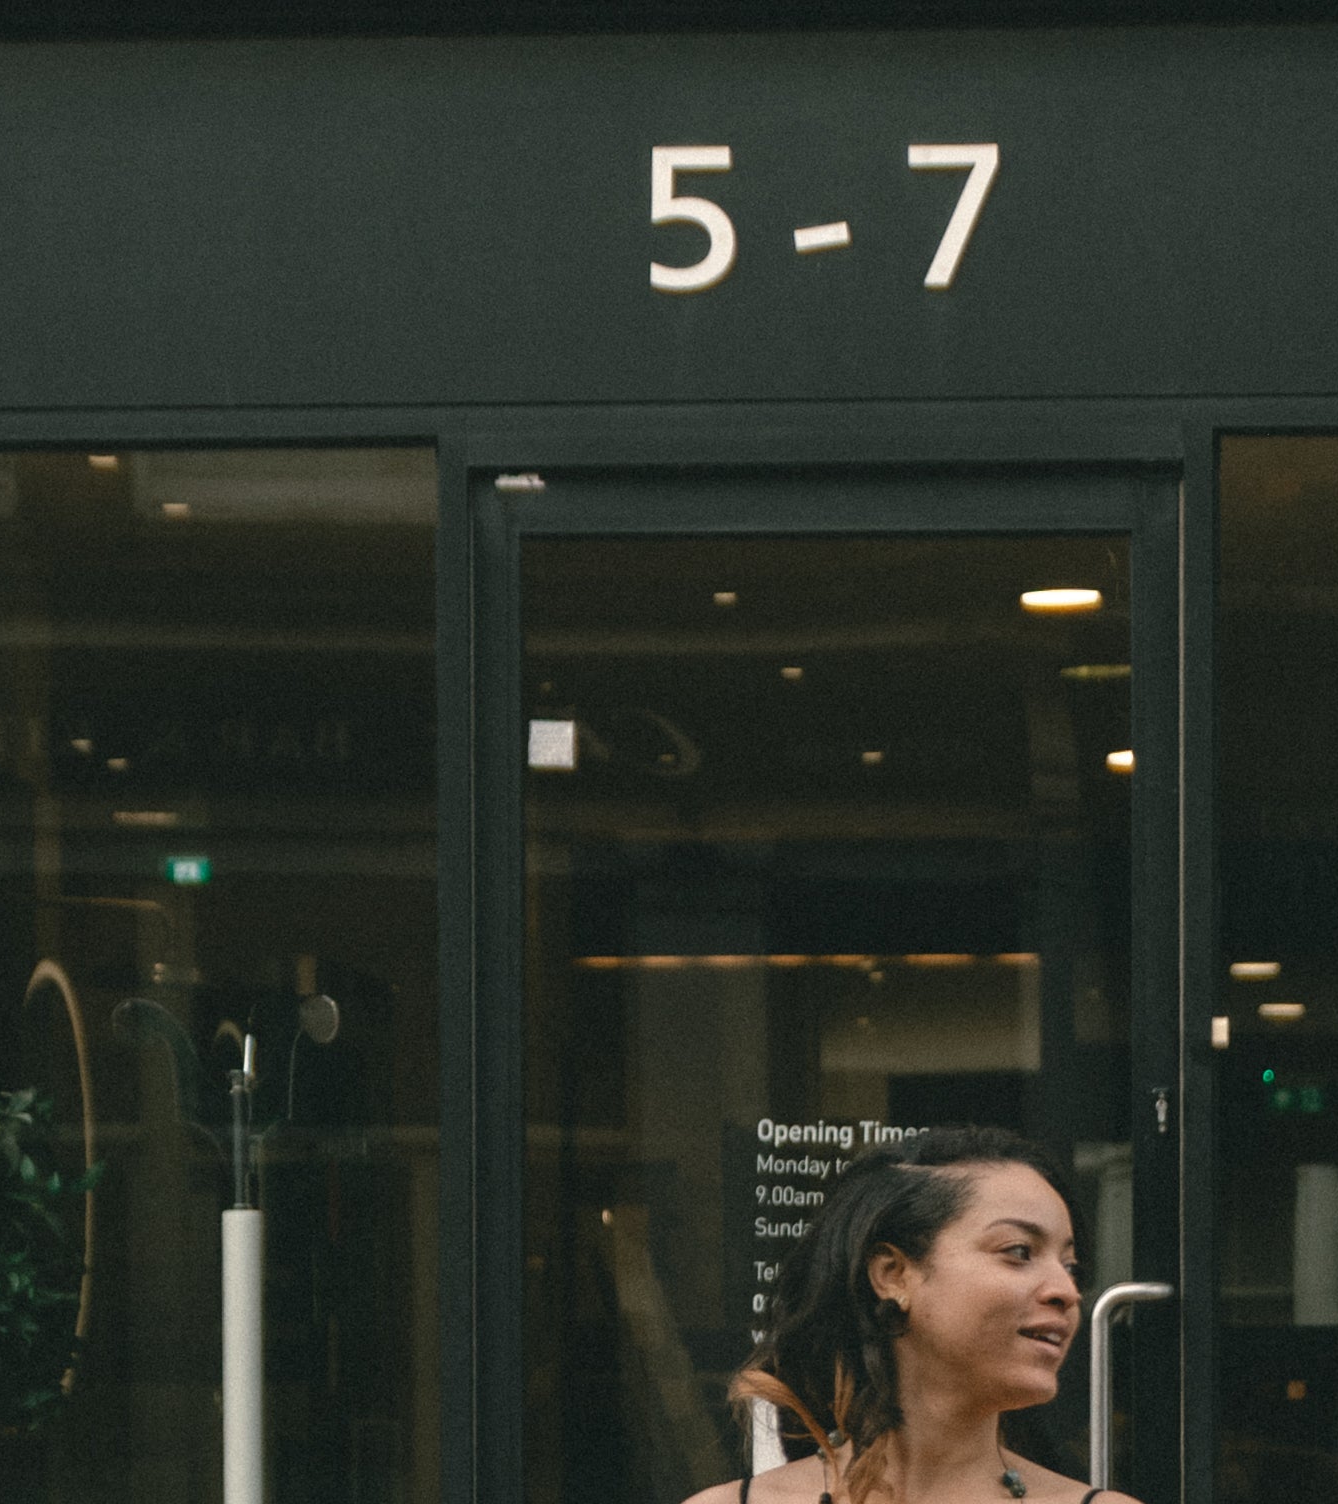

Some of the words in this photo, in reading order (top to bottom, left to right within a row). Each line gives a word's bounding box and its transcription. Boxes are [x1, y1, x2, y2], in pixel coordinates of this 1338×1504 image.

[649, 144, 738, 293] 5
[907, 142, 1000, 289] 7
[756, 1117, 854, 1150] Opening
[755, 1153, 831, 1180] Monday
[754, 1183, 825, 1205] 9.00am
